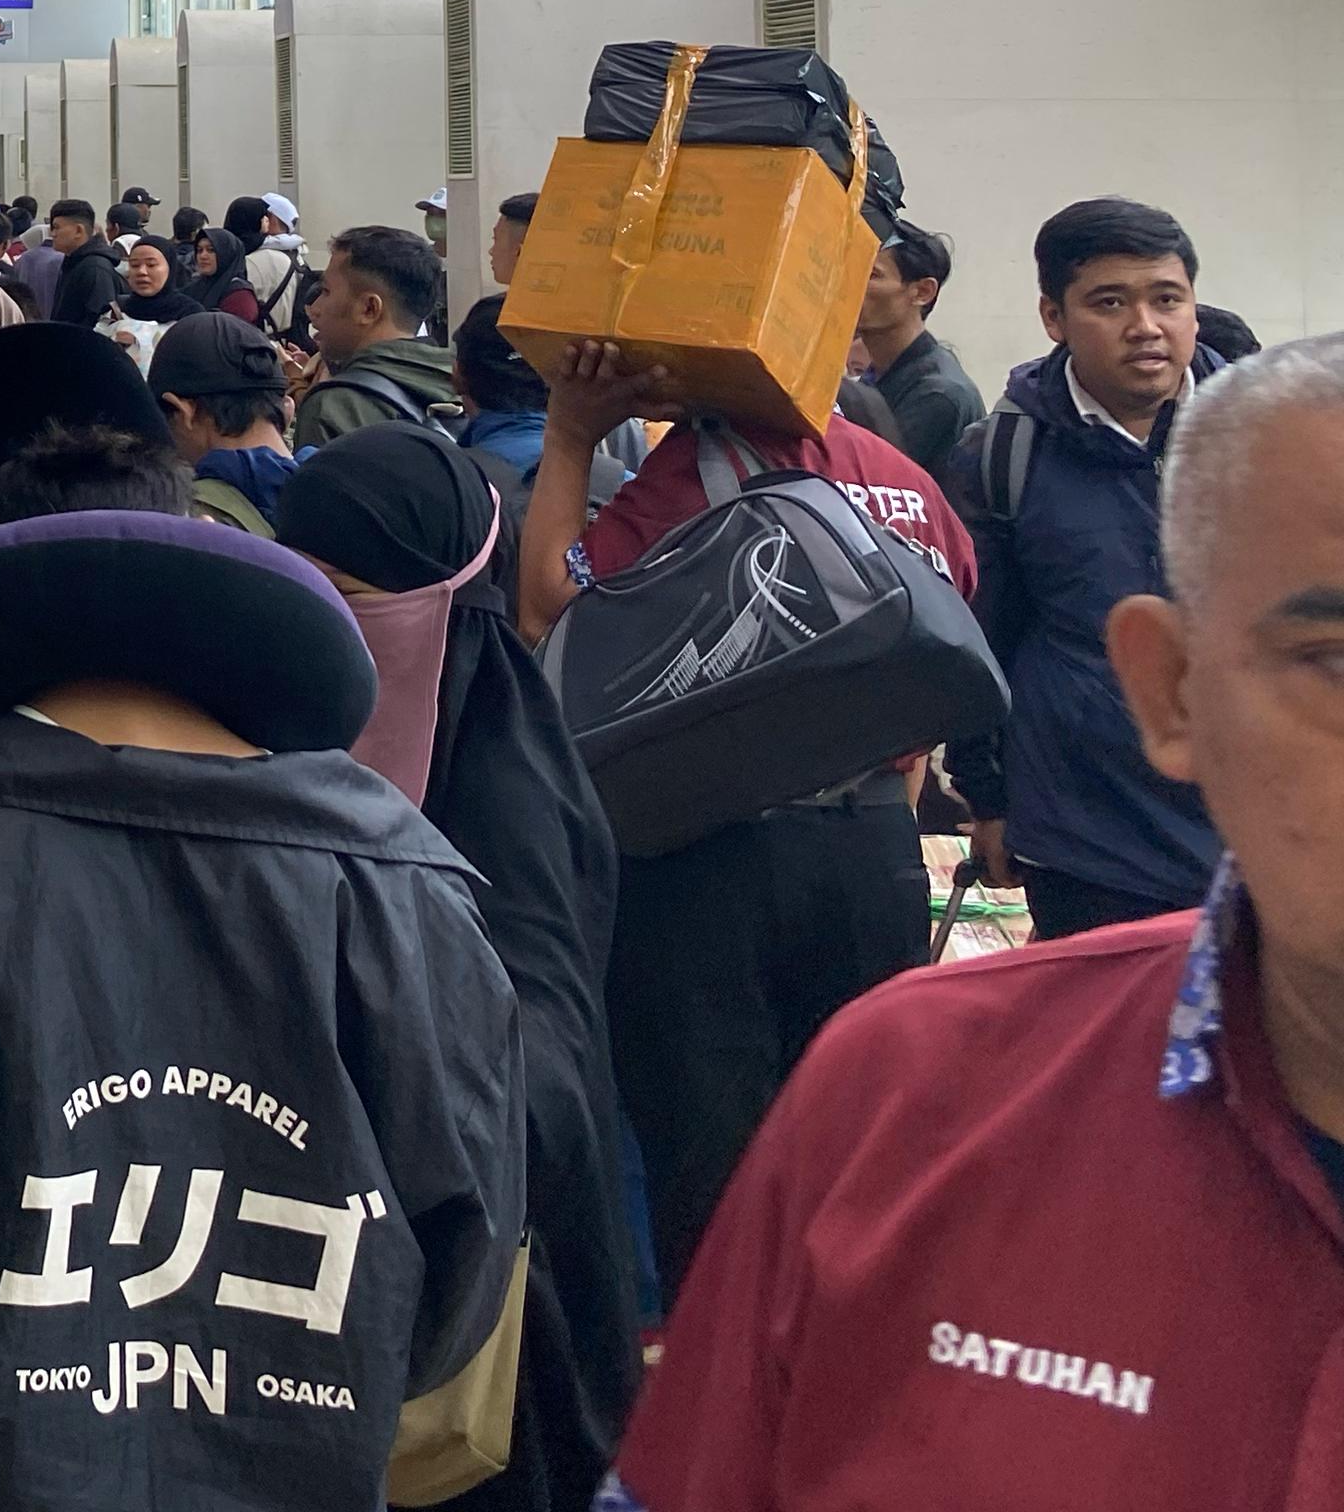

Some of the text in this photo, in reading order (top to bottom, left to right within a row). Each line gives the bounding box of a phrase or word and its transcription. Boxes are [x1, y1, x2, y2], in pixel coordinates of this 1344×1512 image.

[62, 1065, 310, 1151] ERIGO APPAREL
[16, 1340, 356, 1416] TOKYO JPN OSAKA
[927, 1320, 1156, 1416] SATUHAN
